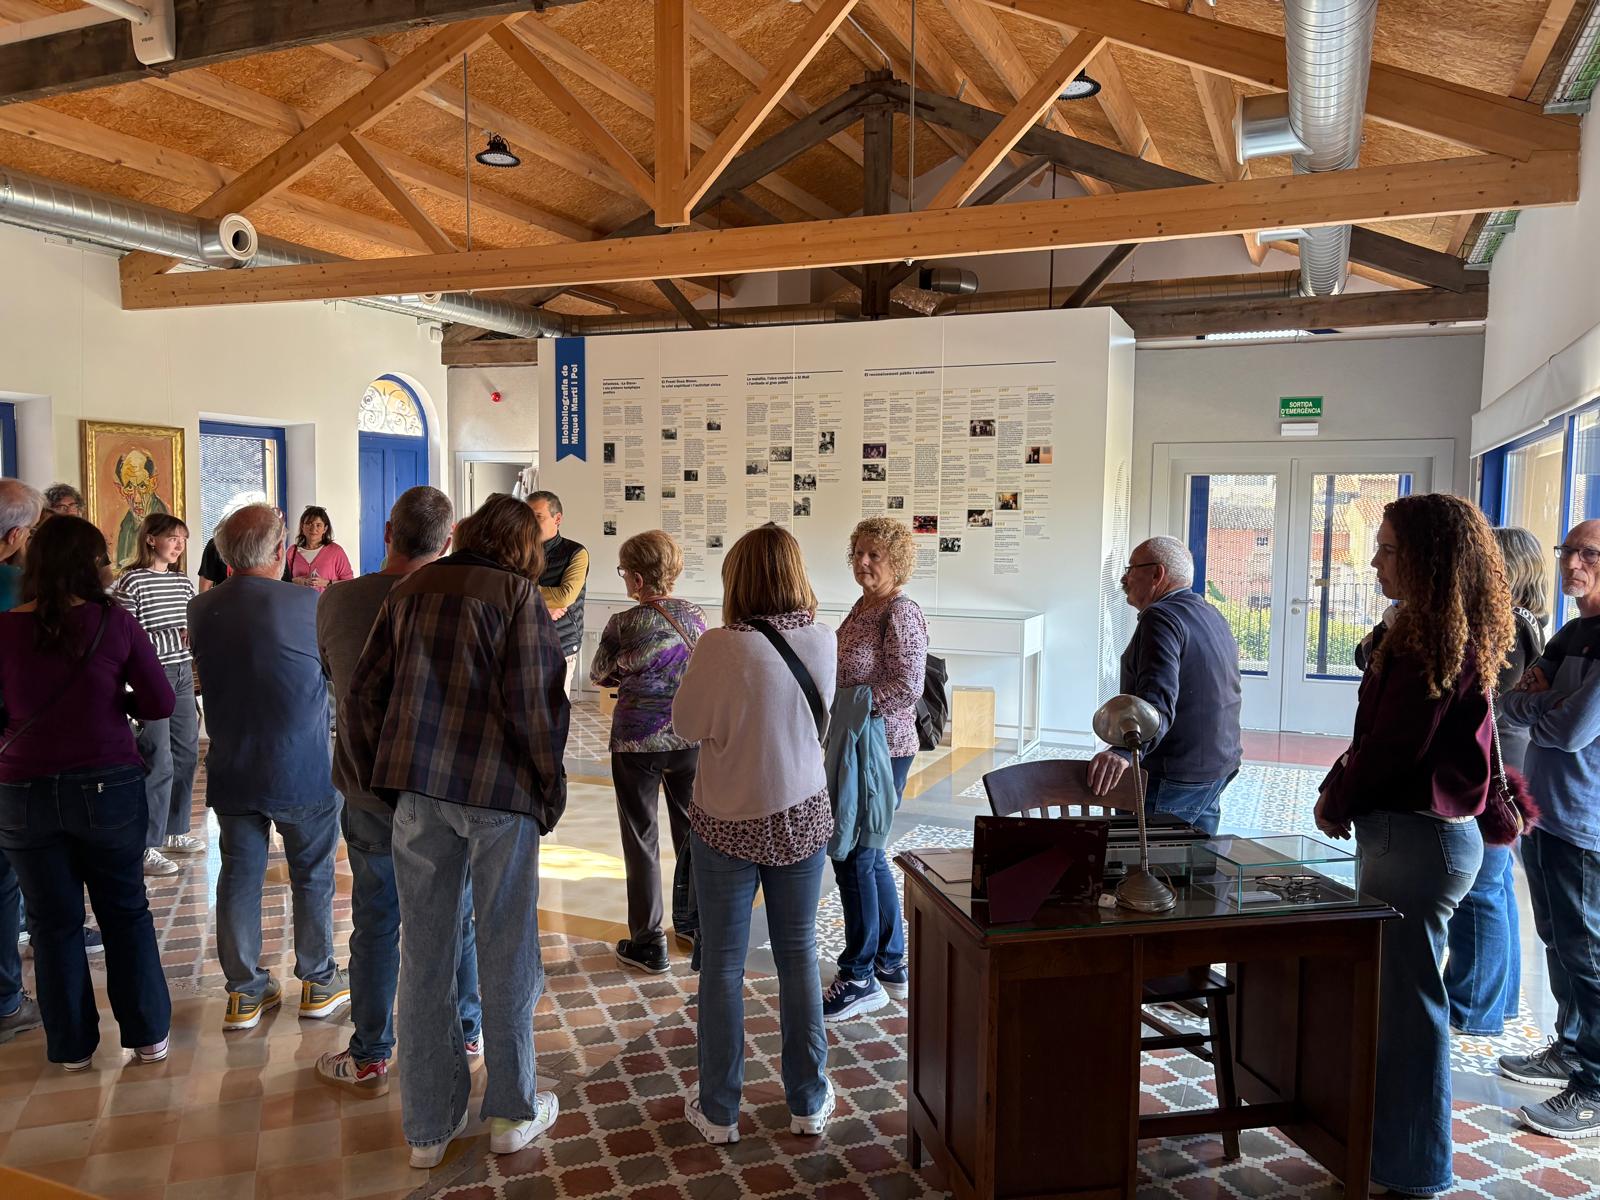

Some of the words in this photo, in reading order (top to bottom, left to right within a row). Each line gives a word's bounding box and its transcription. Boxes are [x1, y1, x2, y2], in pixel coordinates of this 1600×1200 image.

[562, 365, 568, 376] de
[562, 379, 570, 445] Biobibliografia
[570, 414, 580, 445] Miquel
